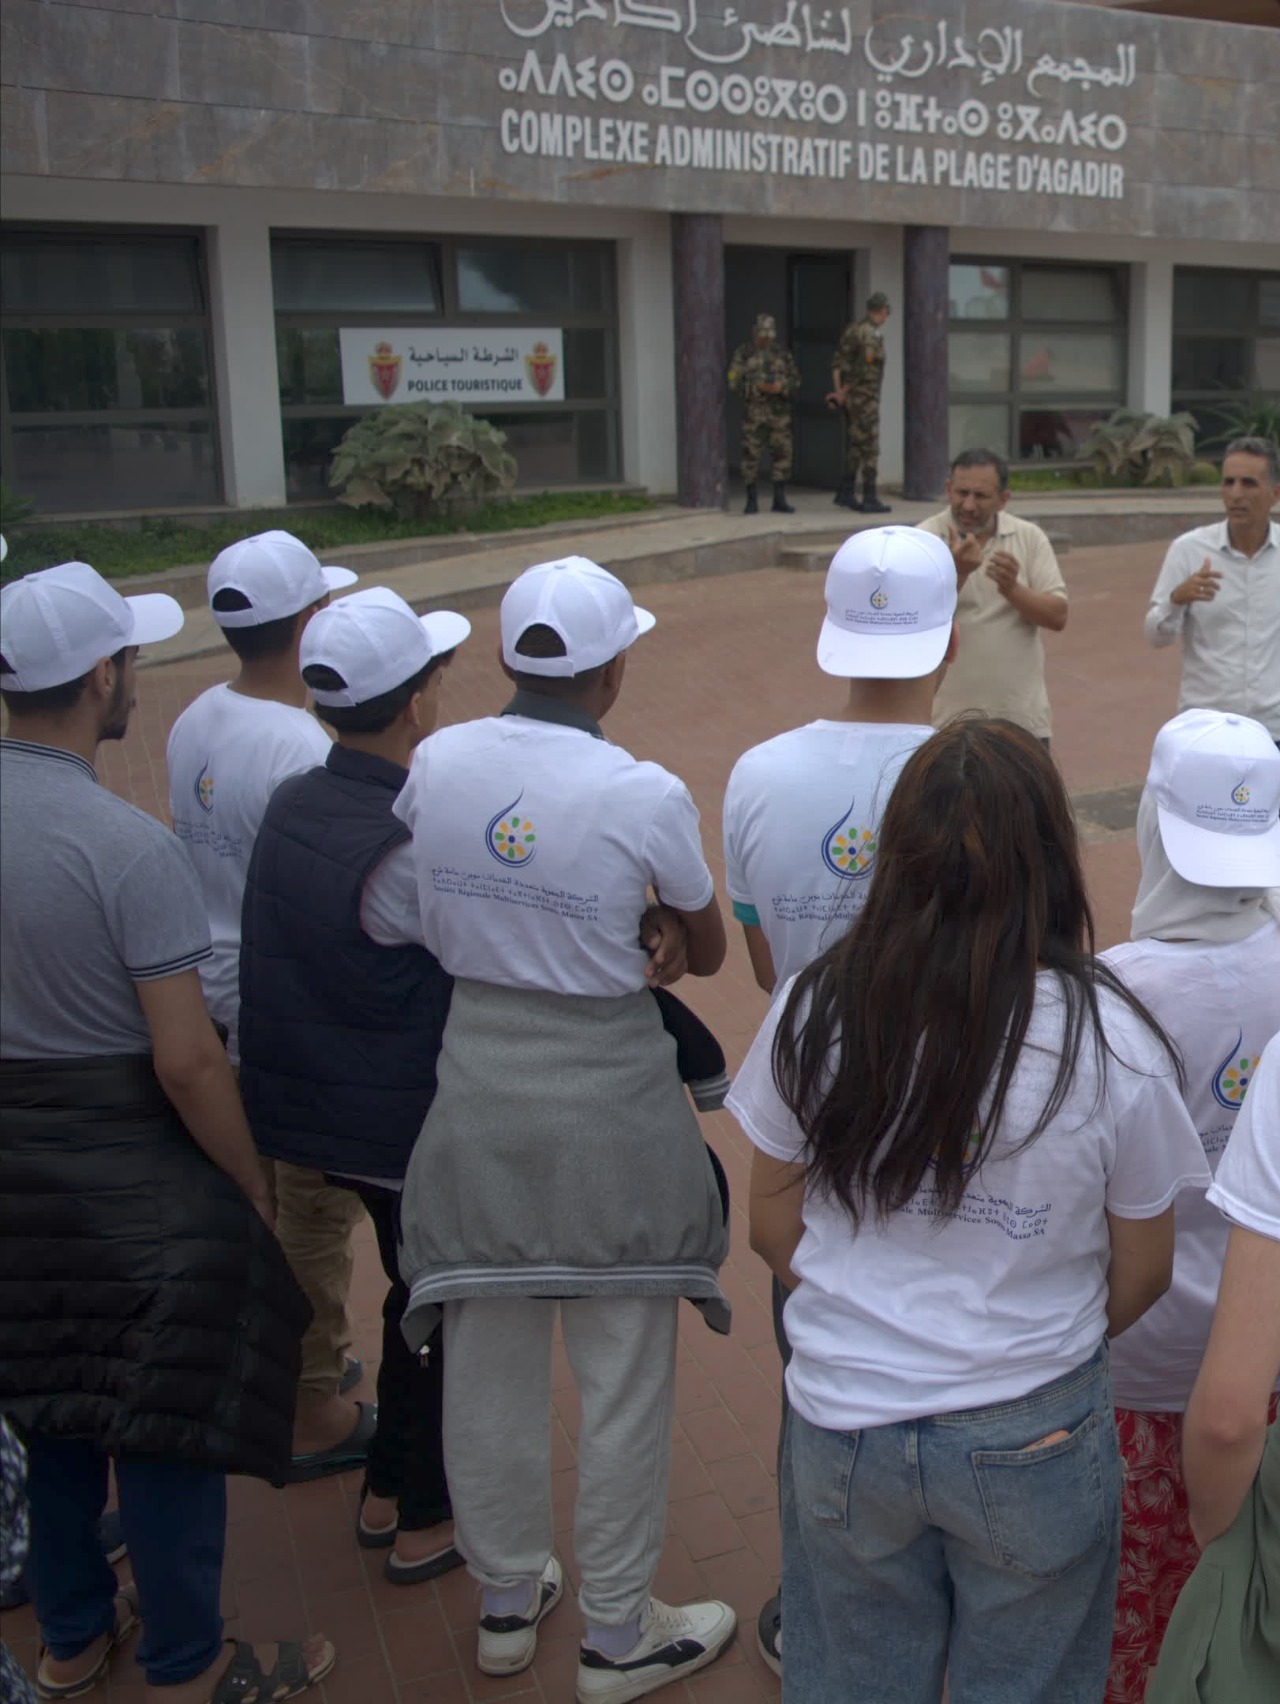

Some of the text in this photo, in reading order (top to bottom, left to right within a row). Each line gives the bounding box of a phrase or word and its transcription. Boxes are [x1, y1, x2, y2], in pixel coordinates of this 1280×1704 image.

[865, 20, 1023, 86] الإداري
[1027, 43, 1137, 97] المجمع
[501, 108, 1124, 199] COMPLEXE ADMINISTRATIF DE LA PLAGE D'AGADIR
[408, 346, 519, 367] الشرطة السياحية
[408, 379, 523, 393] POLICE TOURISTIQUE
[1014, 1203, 1052, 1218] الشركة
